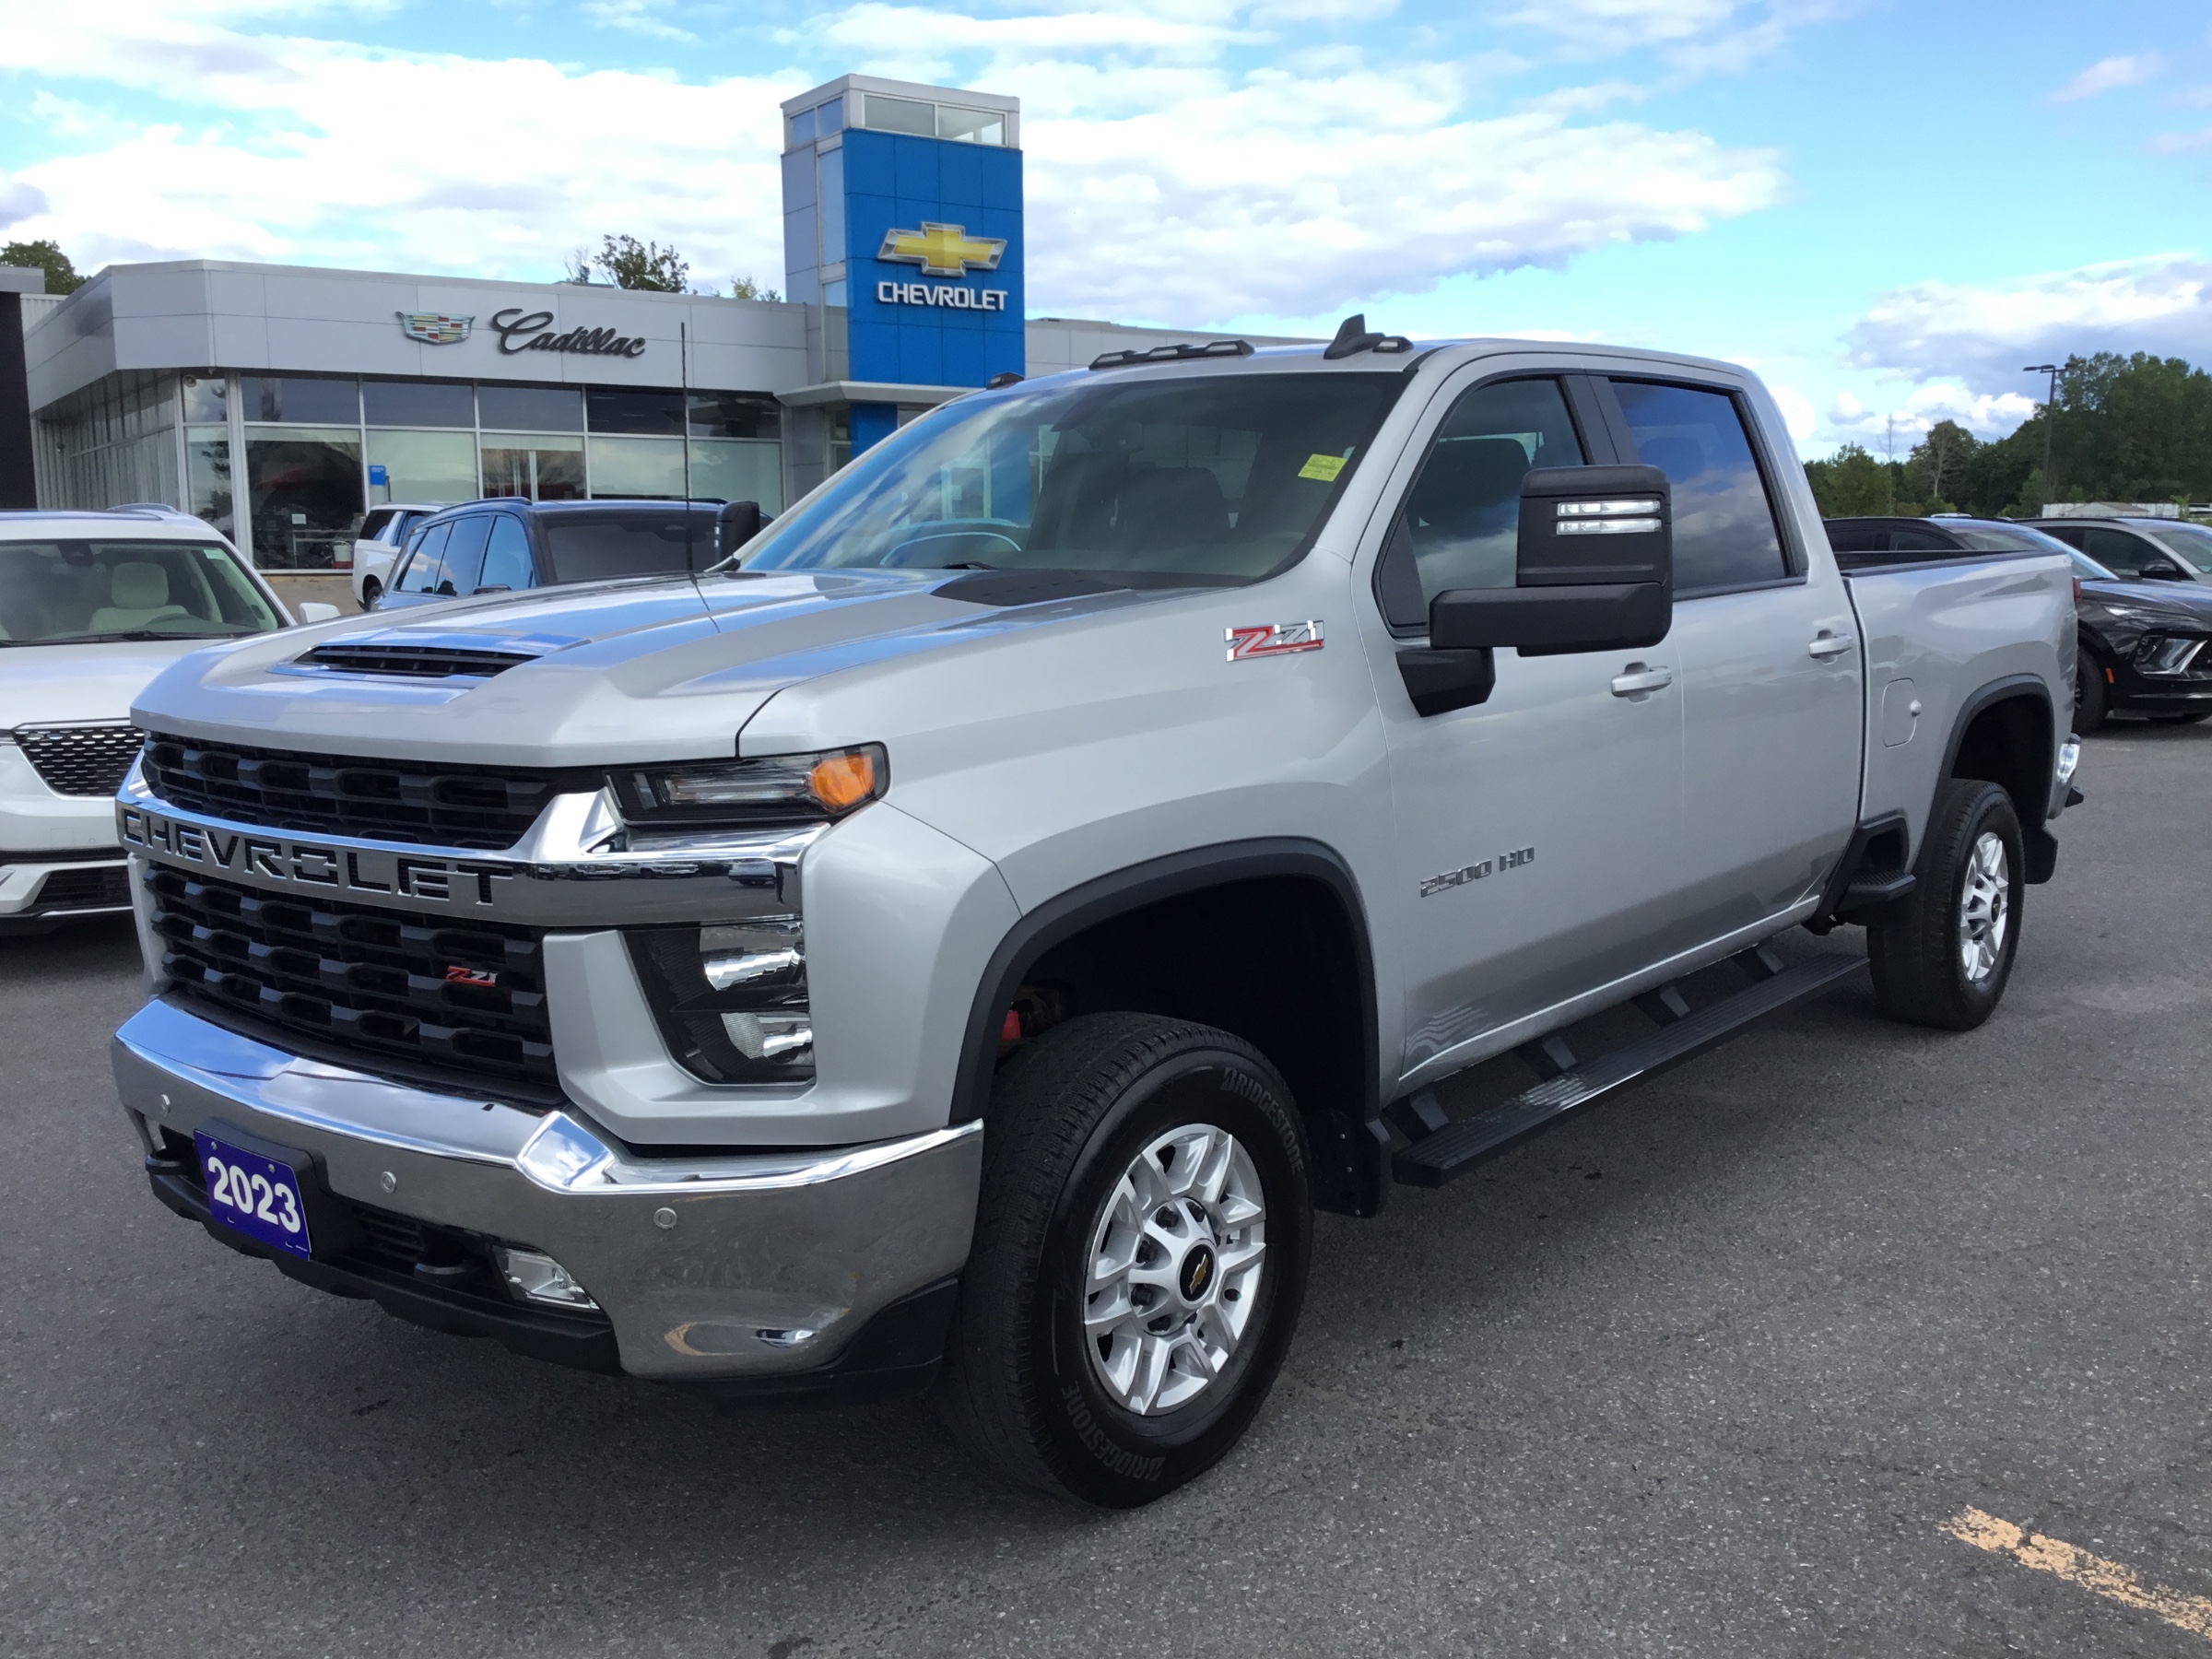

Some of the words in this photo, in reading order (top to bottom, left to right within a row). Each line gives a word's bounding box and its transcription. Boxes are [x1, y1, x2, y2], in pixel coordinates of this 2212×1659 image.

[878, 281, 1009, 311] CHEVROLET
[491, 308, 646, 358] Cadillac
[1224, 619, 1325, 663] Z71
[123, 808, 514, 906] CHEVROLET
[1420, 858, 1493, 899] 2500
[1499, 846, 1535, 872] HD
[445, 965, 499, 988] Z71
[1219, 1066, 1305, 1176] BRIDGESTONE
[207, 1156, 301, 1233] 2023
[1061, 1380, 1167, 1482] BRIDGESTONE
